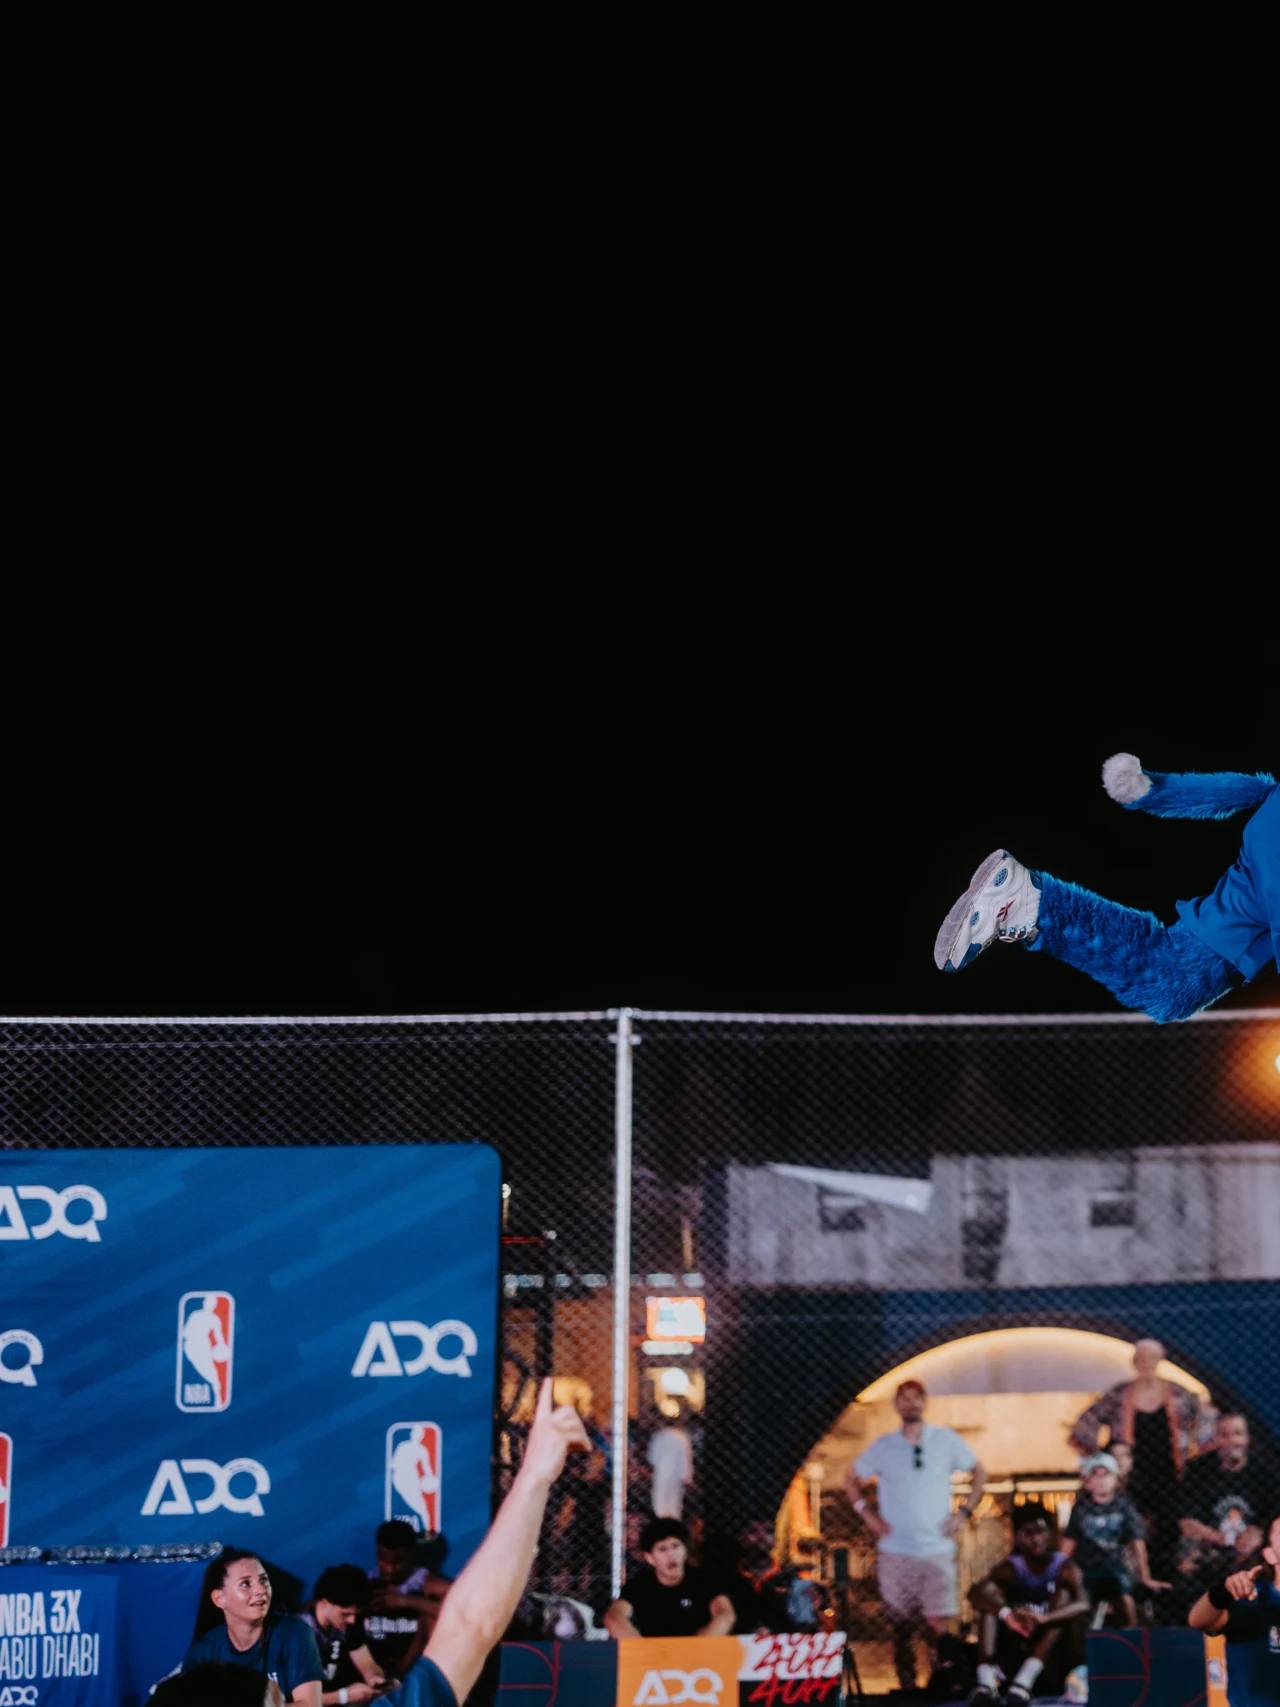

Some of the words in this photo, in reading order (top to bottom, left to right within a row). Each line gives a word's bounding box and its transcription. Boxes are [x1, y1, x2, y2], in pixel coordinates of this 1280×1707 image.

[351, 1319, 478, 1378] ADQ
[185, 1383, 211, 1404] NBA
[140, 1458, 271, 1517] ADQ
[0, 1591, 47, 1637] NBA
[50, 1589, 82, 1634] 3X
[0, 1636, 37, 1680] ABU
[42, 1633, 99, 1679] DHABI
[633, 1668, 724, 1706] ADQ
